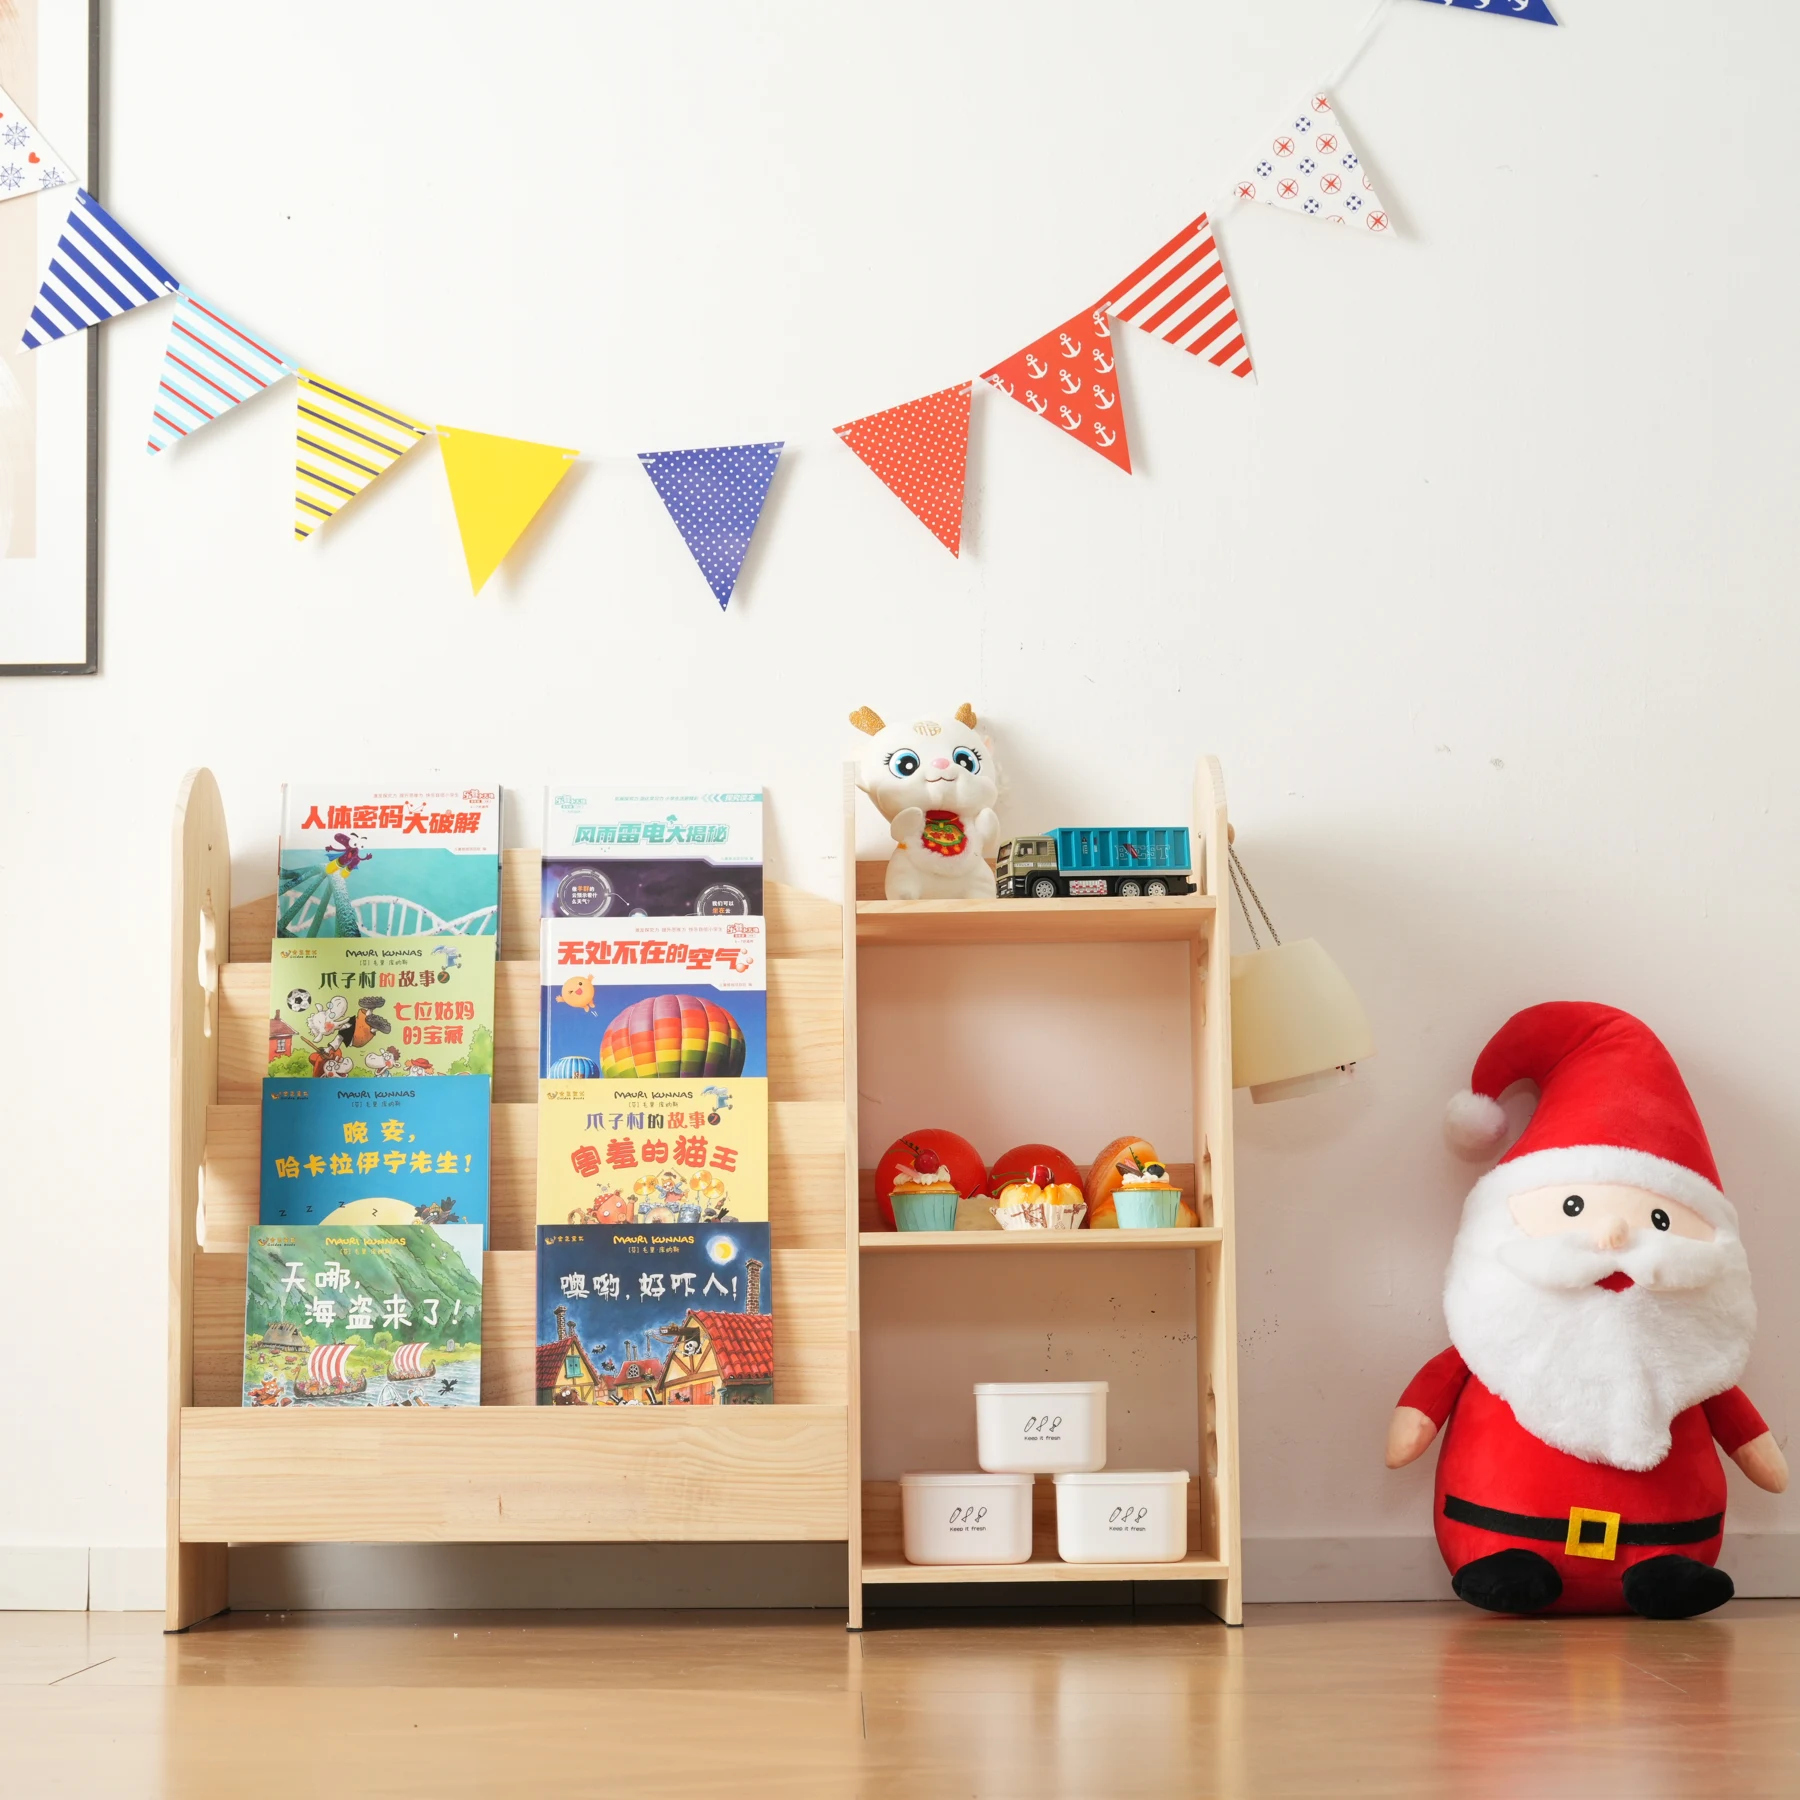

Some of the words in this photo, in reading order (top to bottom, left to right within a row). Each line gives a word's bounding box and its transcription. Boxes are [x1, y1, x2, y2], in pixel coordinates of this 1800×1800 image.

[301, 804, 481, 834] 人体密码大破解
[574, 821, 731, 845] 风雨雷电大揭秘
[346, 949, 379, 957] MAURI
[382, 949, 423, 957] KUNNAS
[557, 939, 749, 971] 无处不在的空气
[393, 1001, 475, 1021] 七位姑妈
[403, 1025, 464, 1045] 的宝藏
[337, 1090, 371, 1099] MAURI
[374, 1090, 416, 1098] KUNNAS
[614, 1090, 648, 1099] MAURI
[651, 1091, 694, 1099] KUNNAS
[275, 1150, 472, 1179] 哈卡拉伊宁先生！
[570, 1135, 739, 1177] 害羞的猫王
[325, 1237, 360, 1246] MAURI
[363, 1237, 406, 1246] KUNNAS
[613, 1235, 648, 1245] MAURI
[651, 1235, 695, 1244] KUNNAS
[304, 1294, 461, 1330] 海盗来了！
